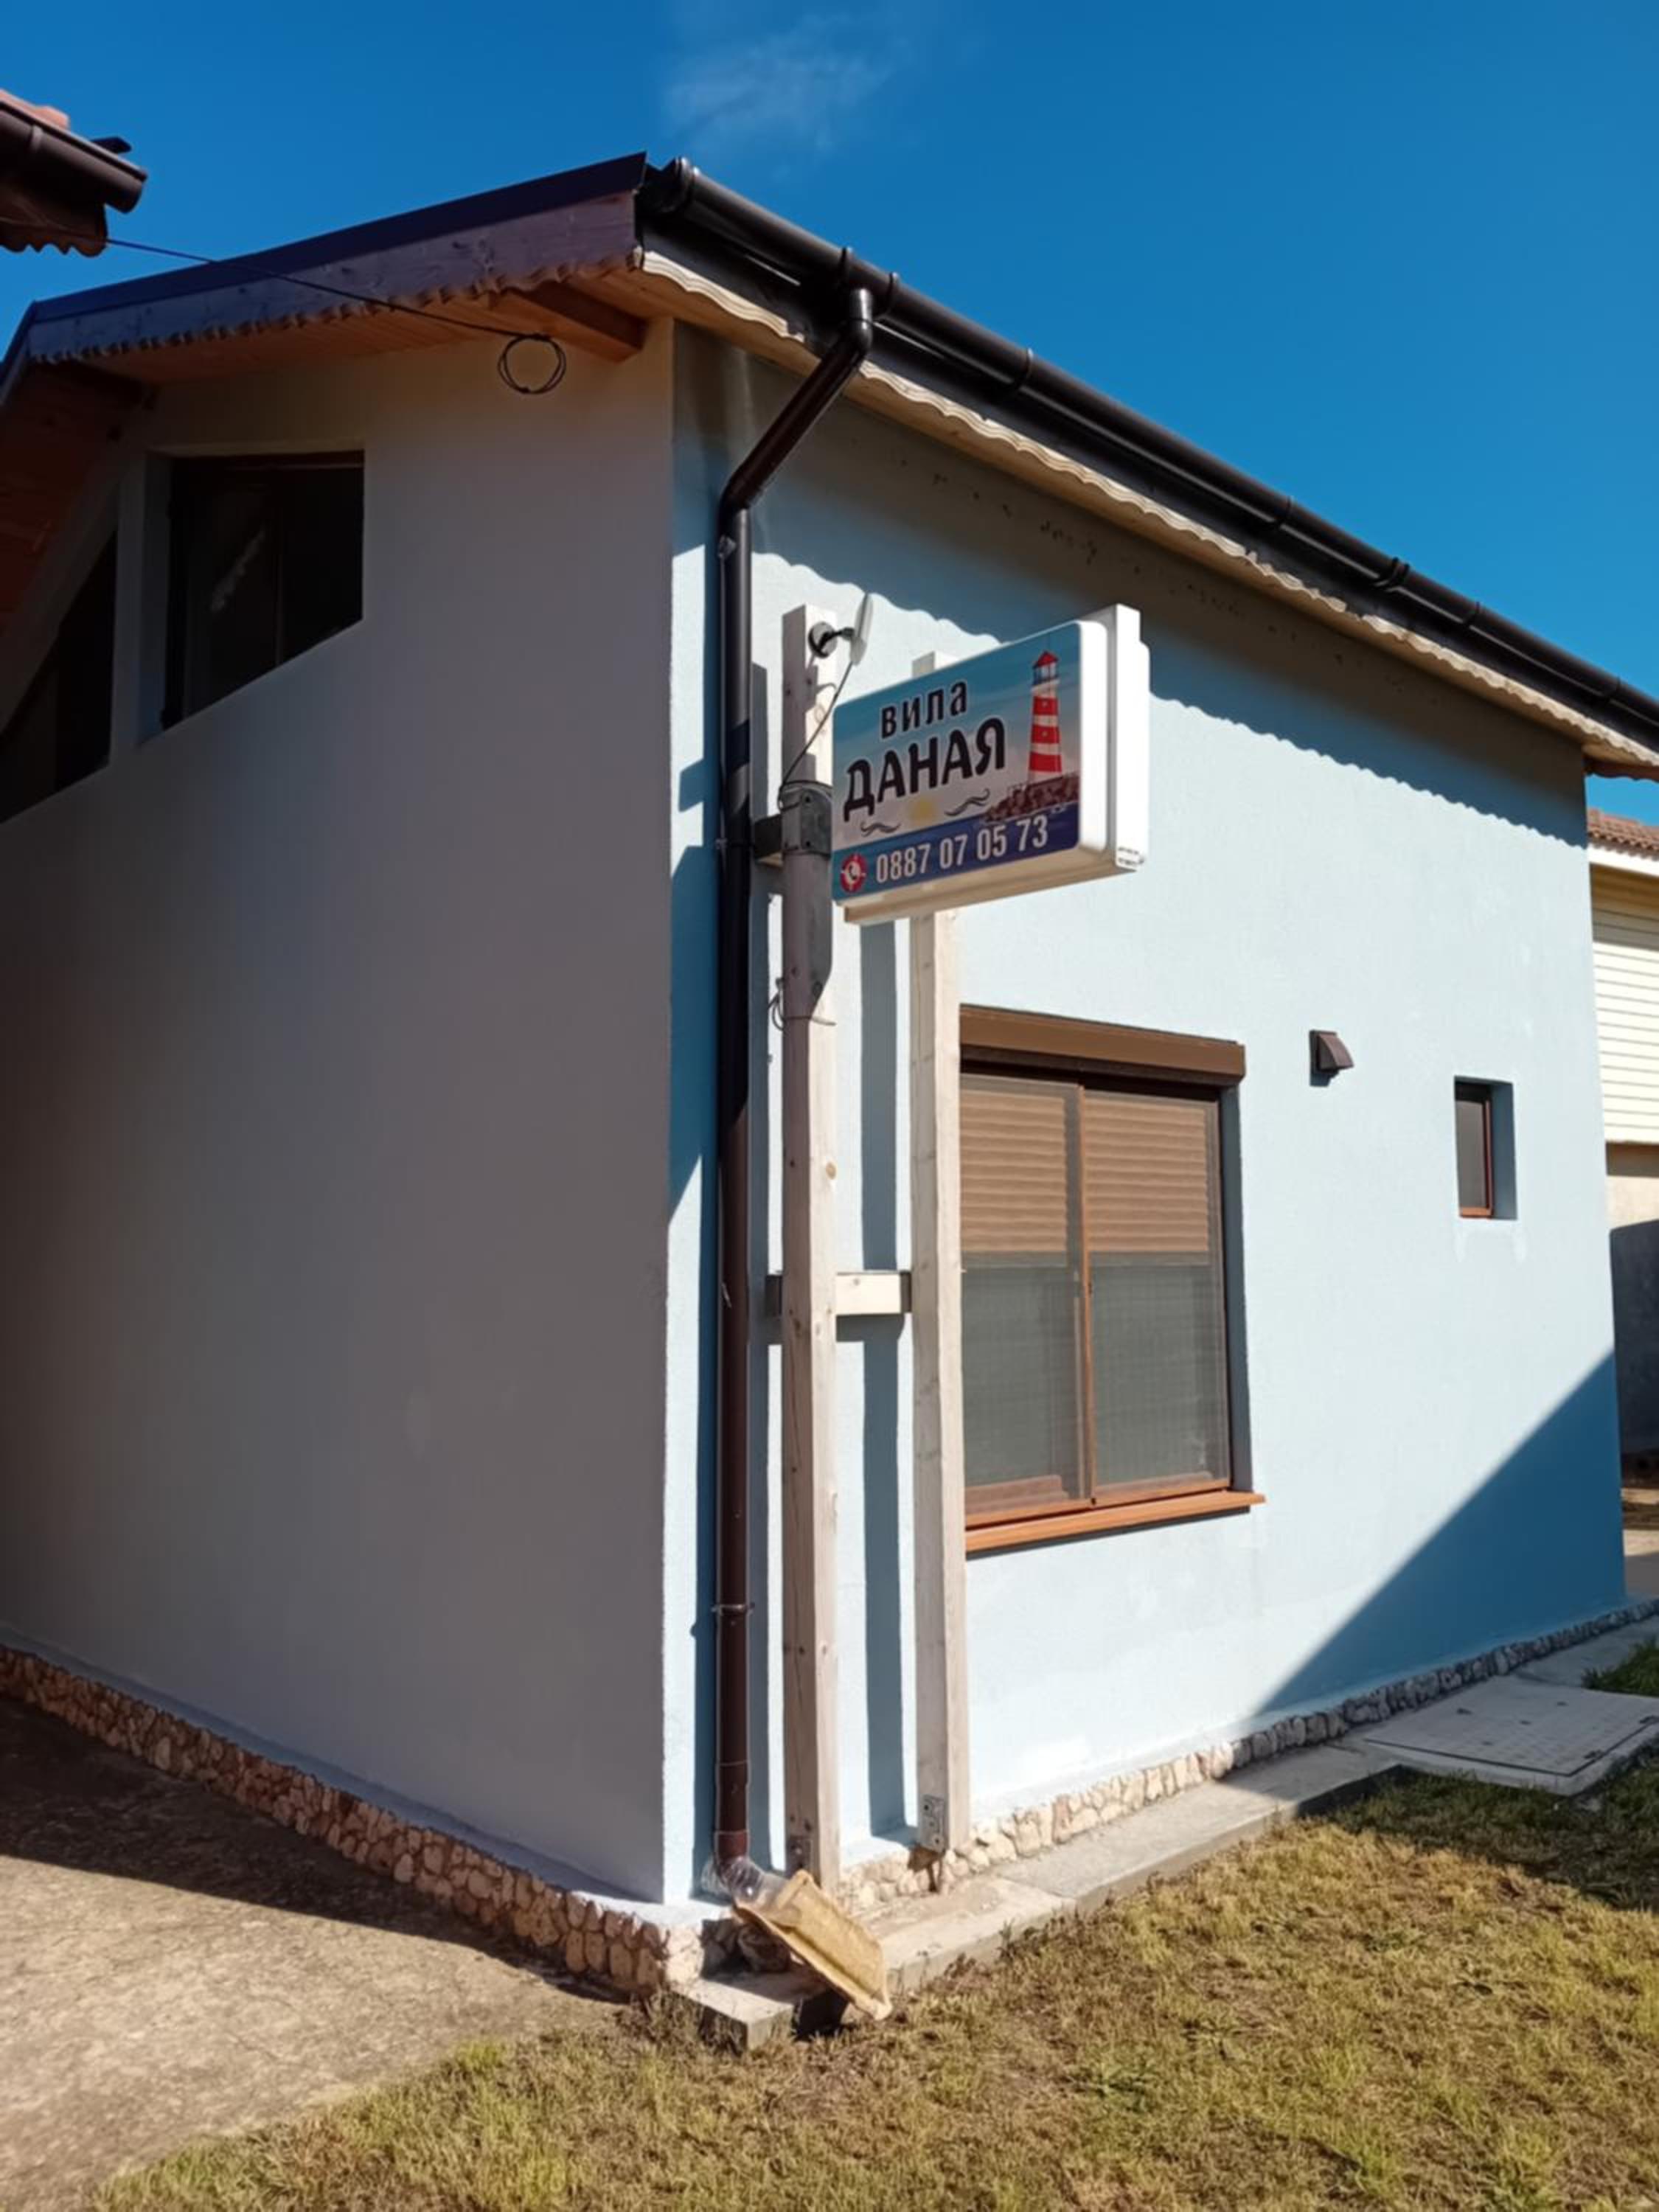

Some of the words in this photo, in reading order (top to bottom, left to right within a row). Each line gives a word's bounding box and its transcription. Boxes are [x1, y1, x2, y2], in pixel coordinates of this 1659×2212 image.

[844, 718, 1005, 821] ДАНАЯ
[875, 844, 931, 884] 0887
[939, 835, 967, 869] 07
[977, 825, 1006, 858] 05
[1017, 815, 1048, 852] 73
